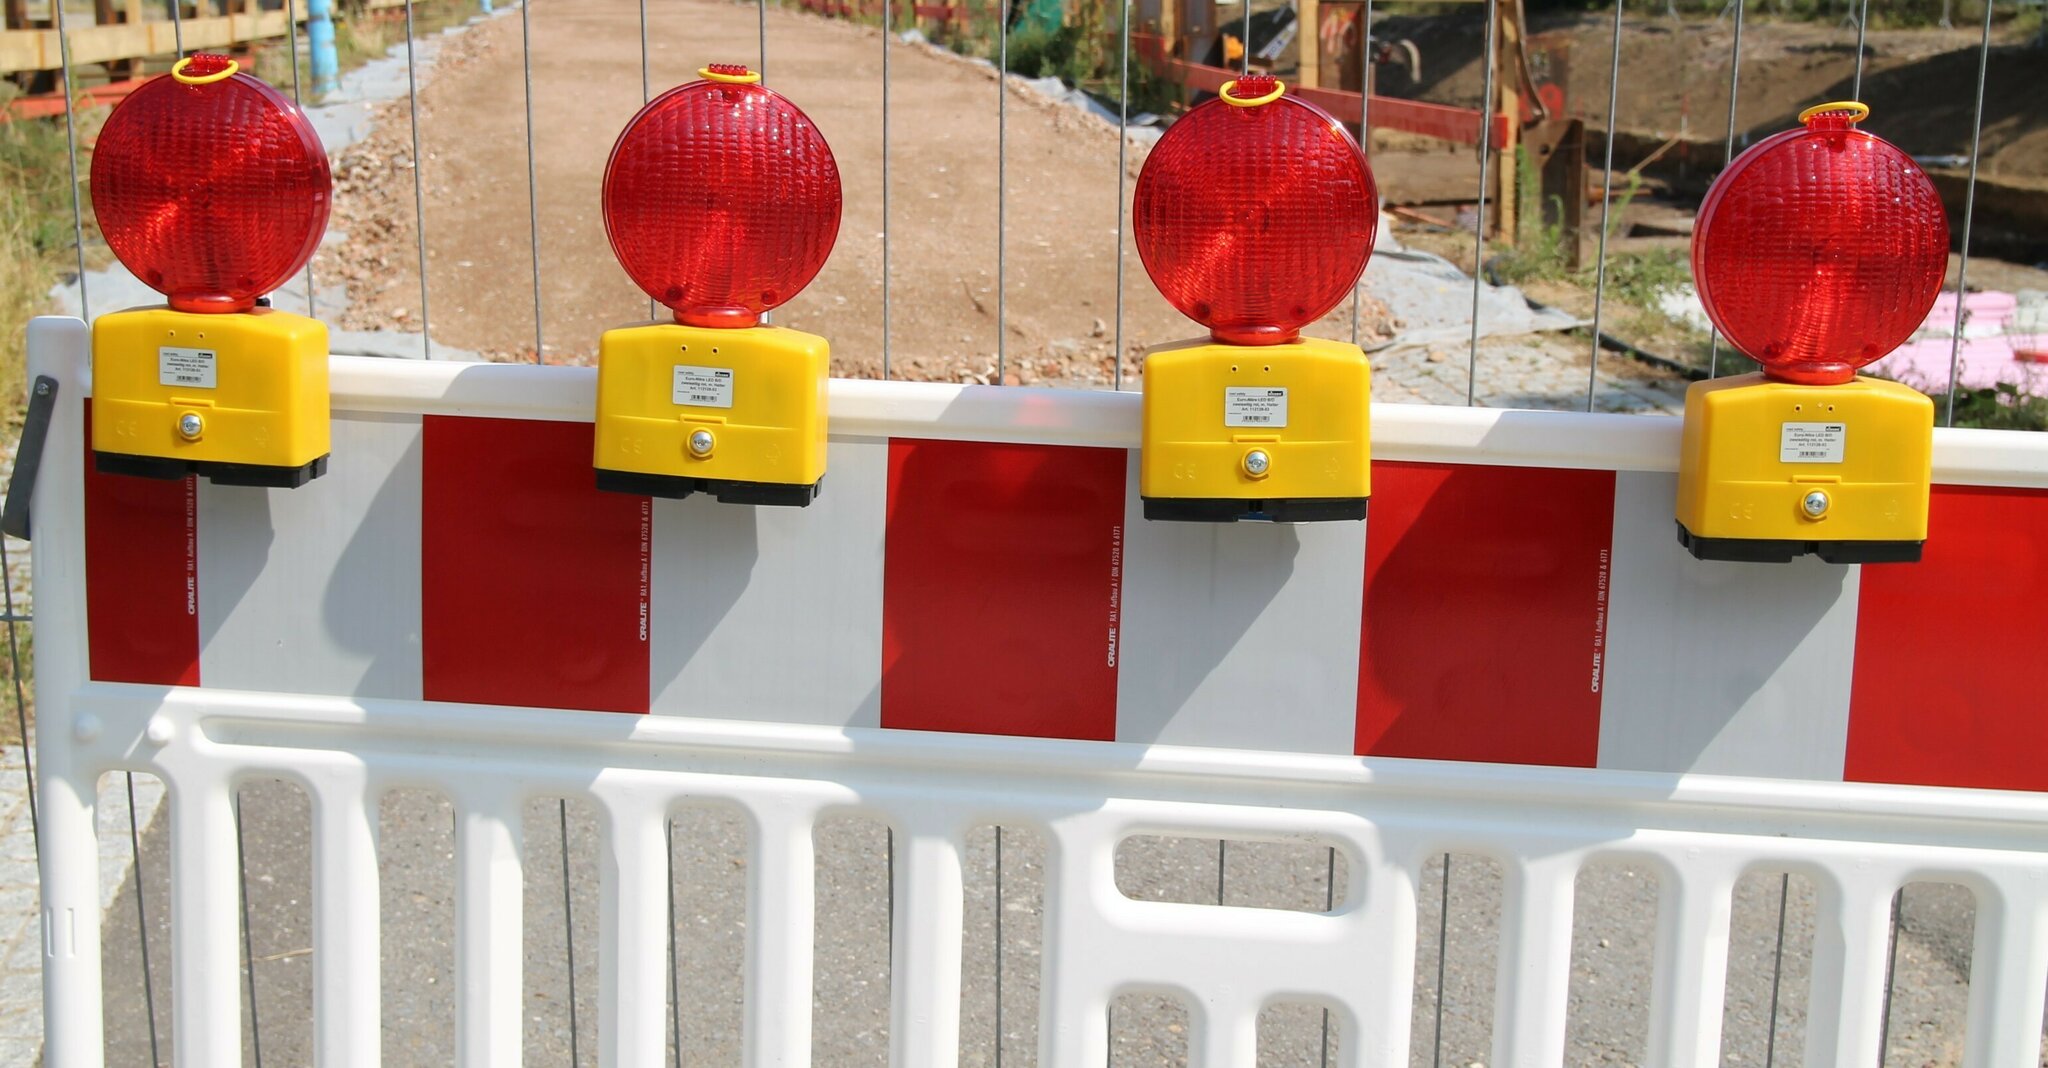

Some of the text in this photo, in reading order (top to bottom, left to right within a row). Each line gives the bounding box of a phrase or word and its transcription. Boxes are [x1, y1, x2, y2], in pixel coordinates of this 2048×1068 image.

[1112, 548, 1120, 566] 67520
[1600, 550, 1608, 563] 6171
[1598, 570, 1606, 590] 67520
[1110, 588, 1118, 608] Aufbau
